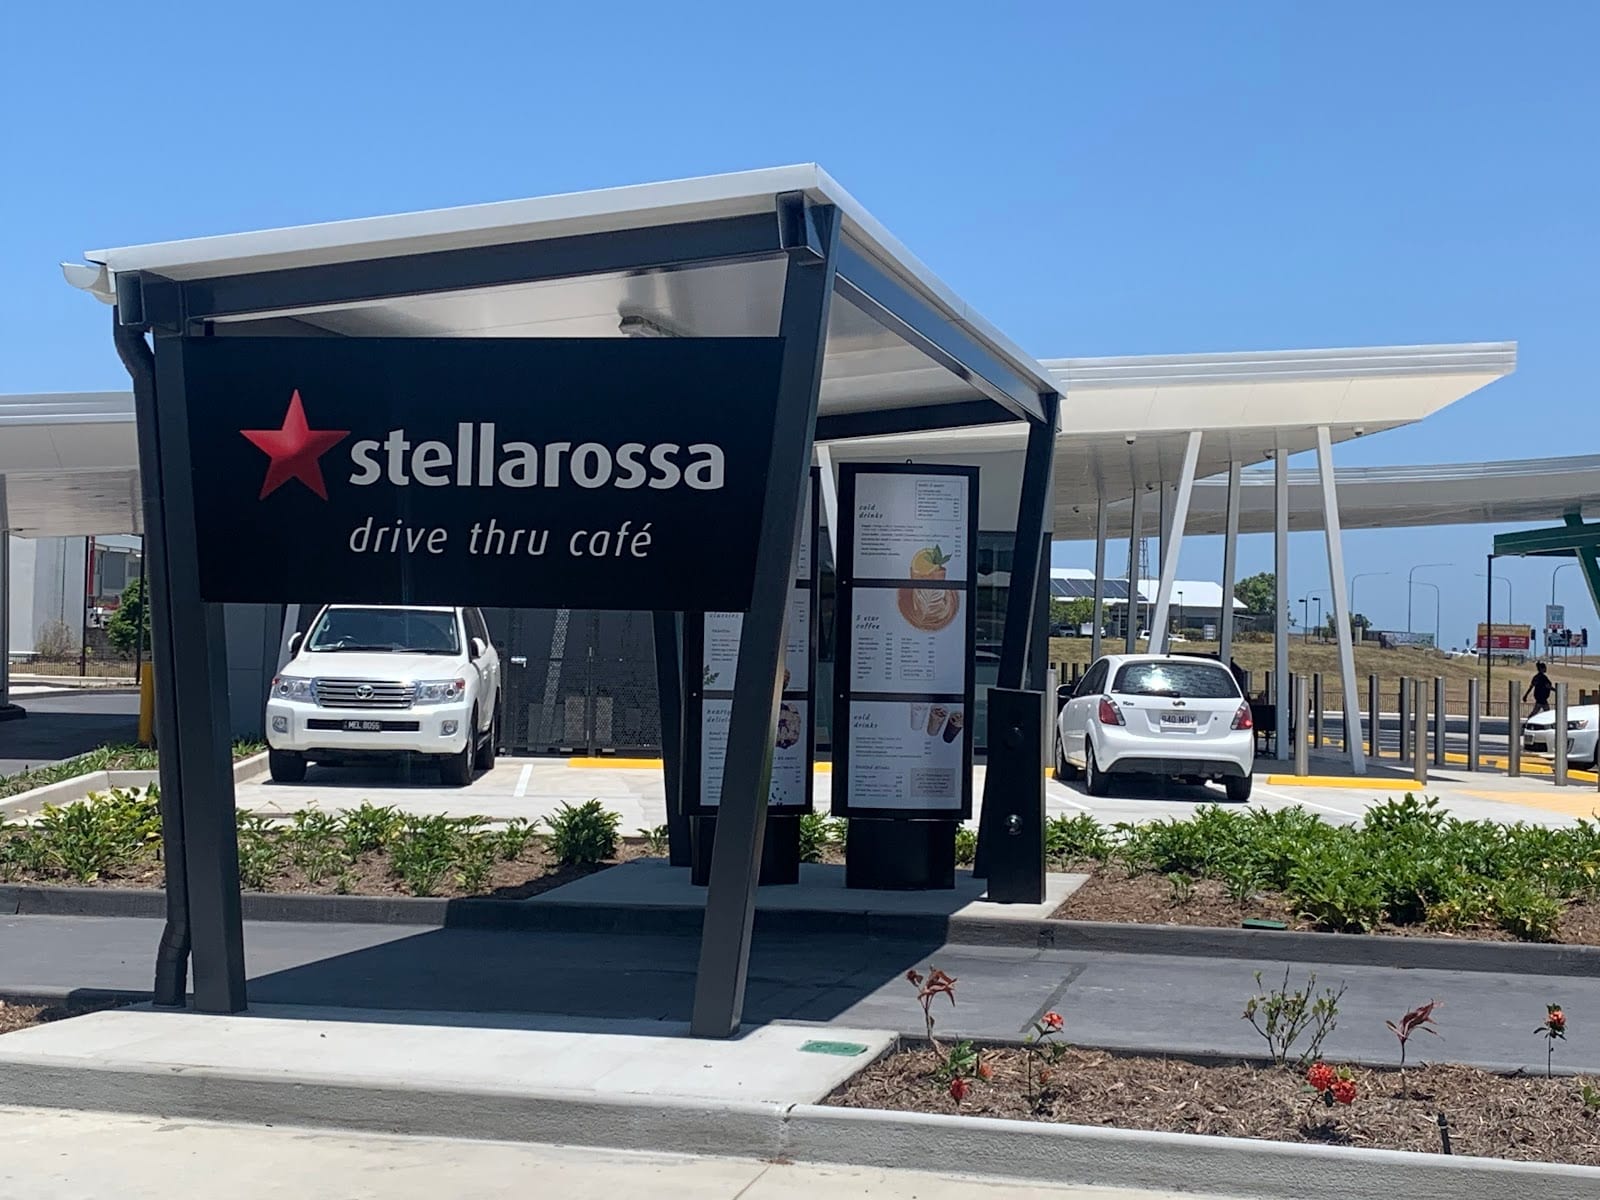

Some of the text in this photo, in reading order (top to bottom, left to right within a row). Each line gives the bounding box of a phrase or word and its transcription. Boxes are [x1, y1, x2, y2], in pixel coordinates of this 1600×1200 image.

[349, 422, 725, 490] stellarossa
[349, 517, 653, 557] drive thru café
